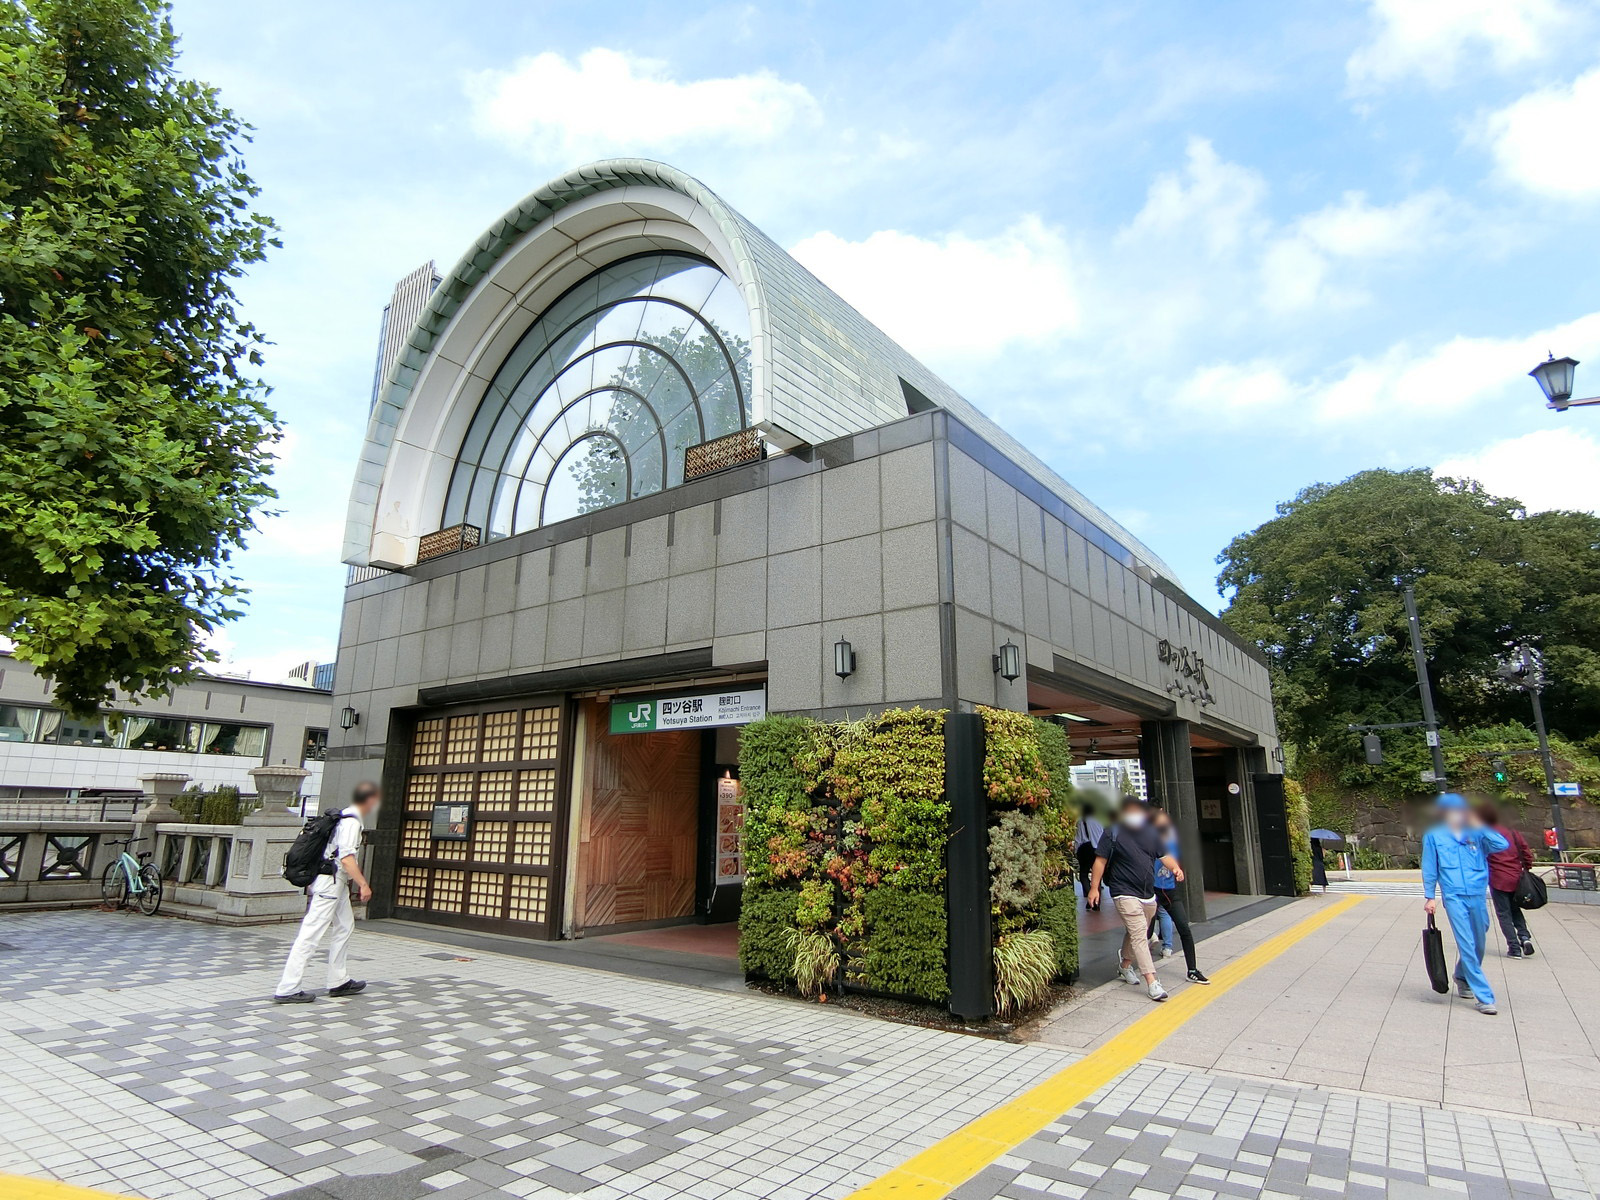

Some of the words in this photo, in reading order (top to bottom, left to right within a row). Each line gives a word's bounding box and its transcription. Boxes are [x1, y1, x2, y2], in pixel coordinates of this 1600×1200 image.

[628, 703, 652, 723] JR
[662, 699, 703, 715] 四ツ谷駅
[662, 716, 688, 726] Yotsuya
[689, 714, 713, 723] Station
